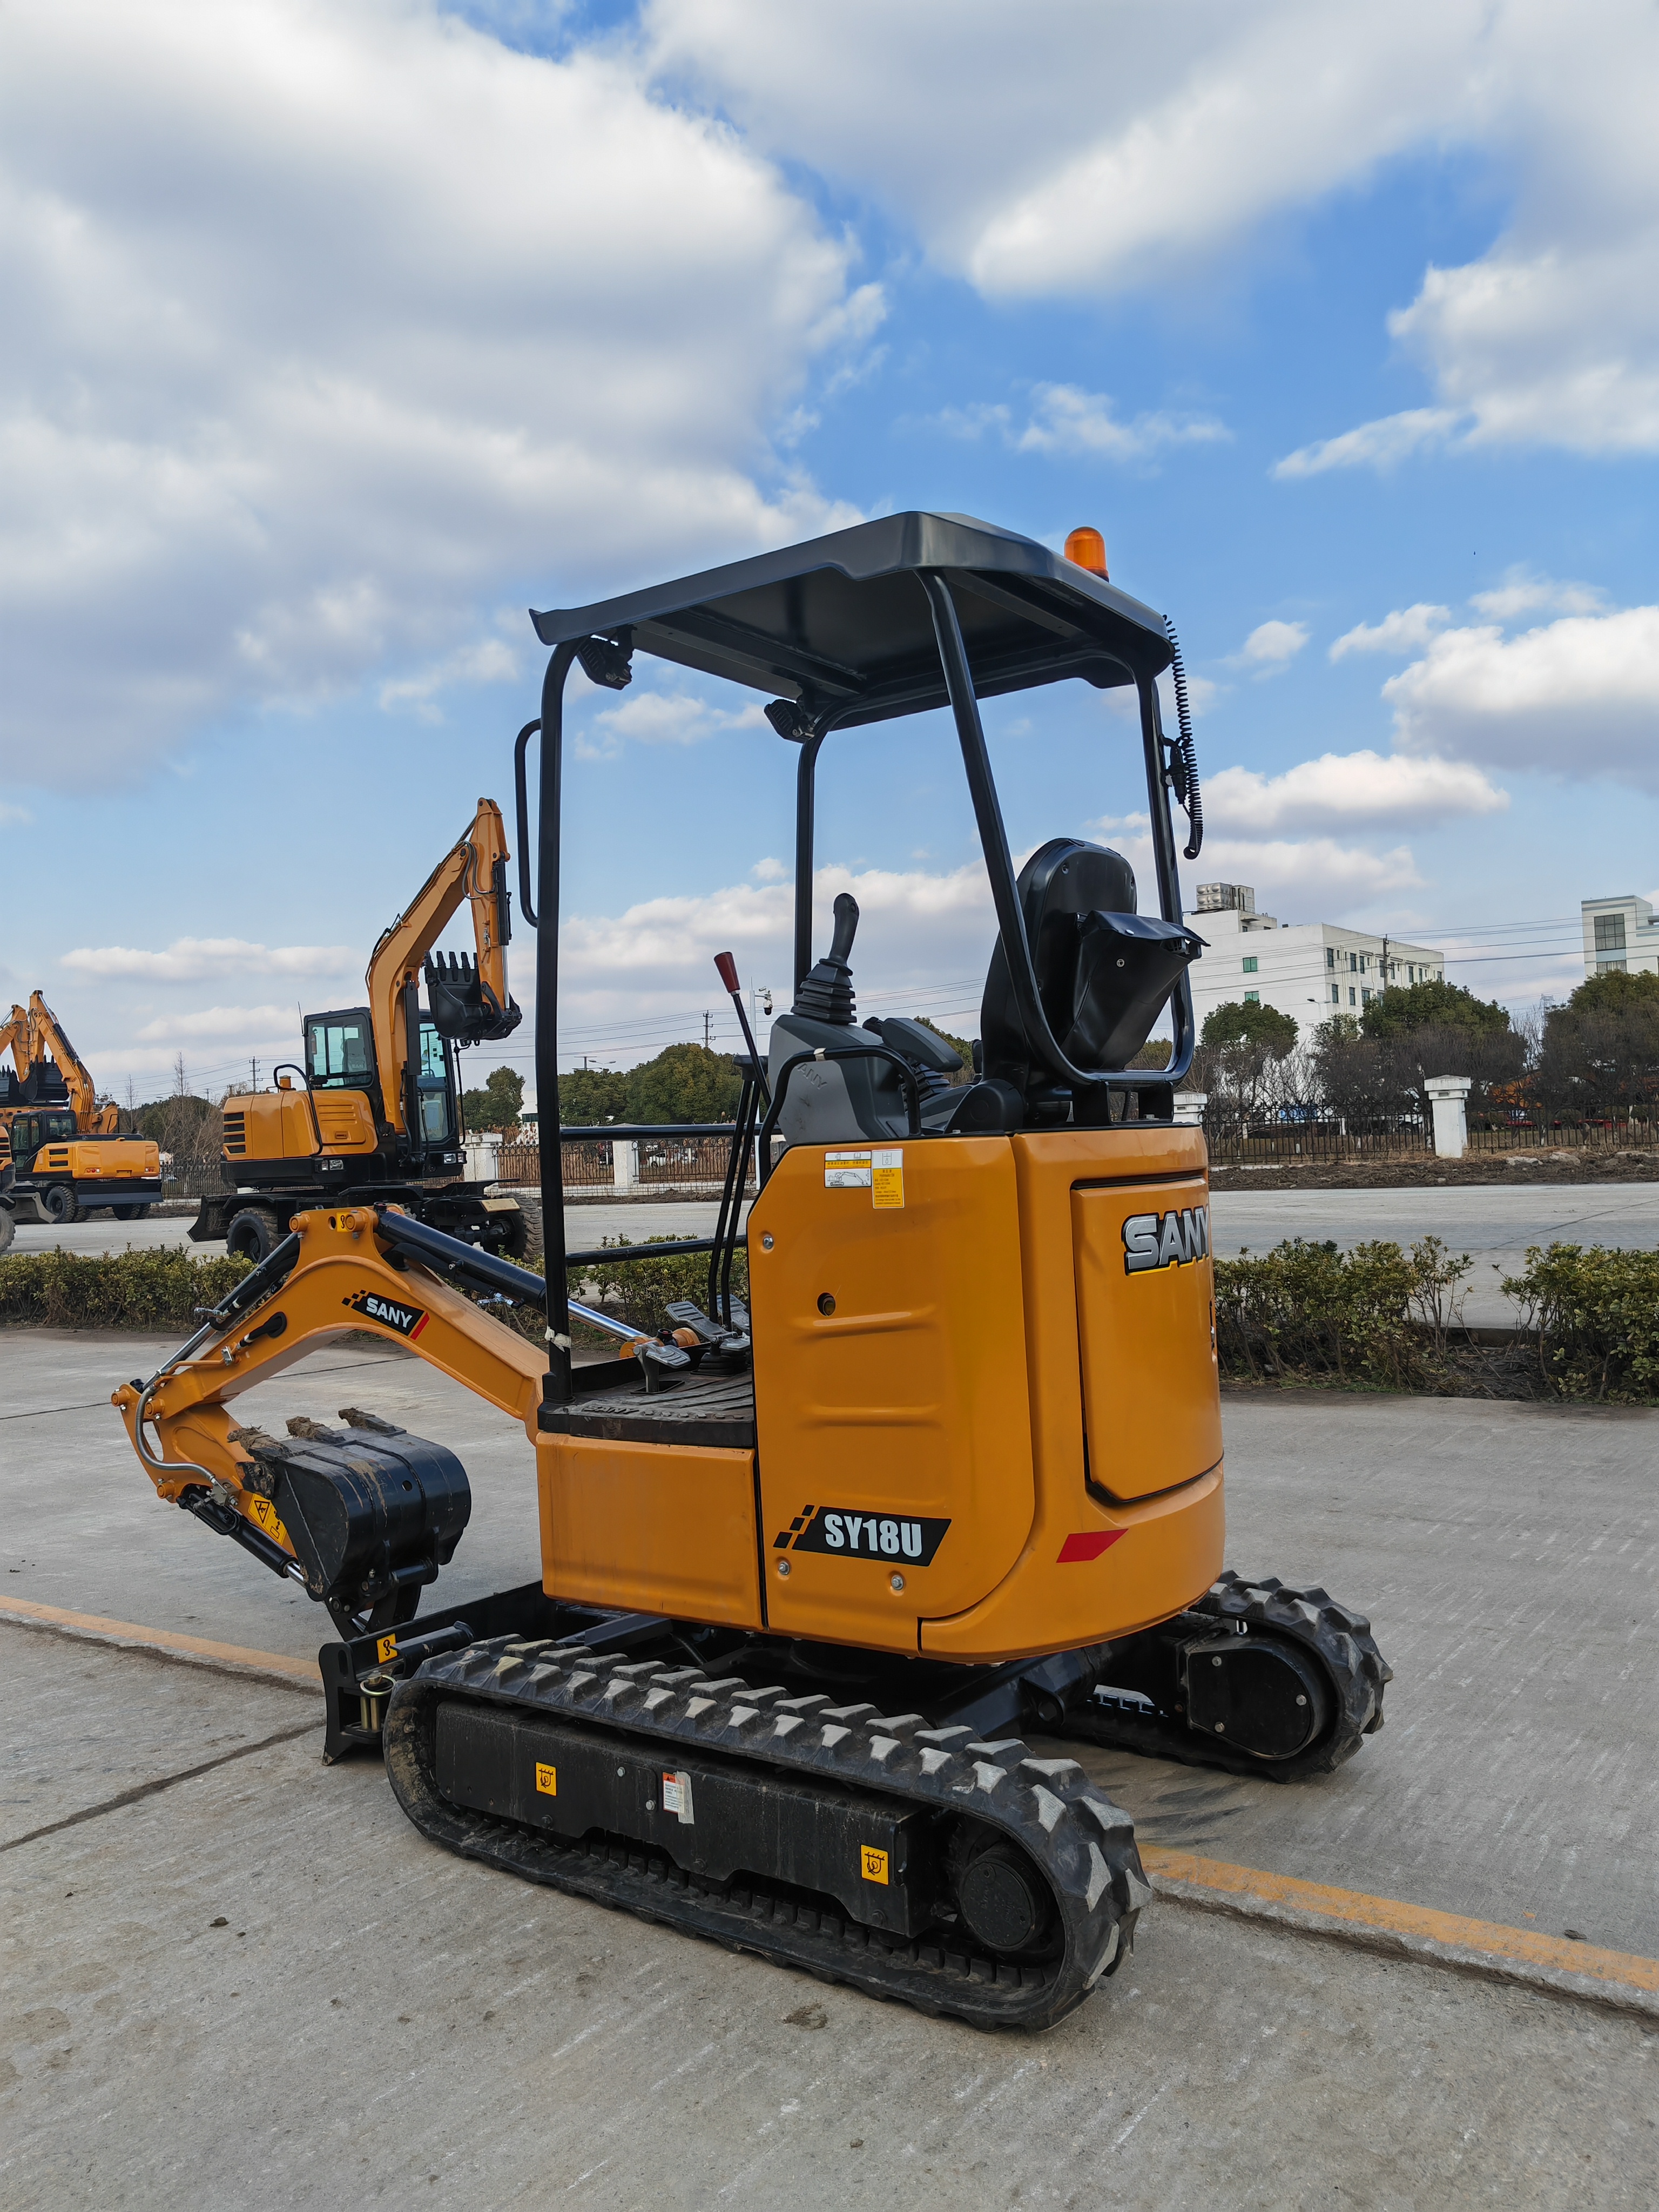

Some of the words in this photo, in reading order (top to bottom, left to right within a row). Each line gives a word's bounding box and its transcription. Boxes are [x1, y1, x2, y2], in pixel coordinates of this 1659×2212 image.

[795, 1063, 827, 1090] ANY
[366, 1297, 413, 1328] SANY
[584, 1405, 639, 1414] SANY
[824, 1514, 923, 1557] SY18U
